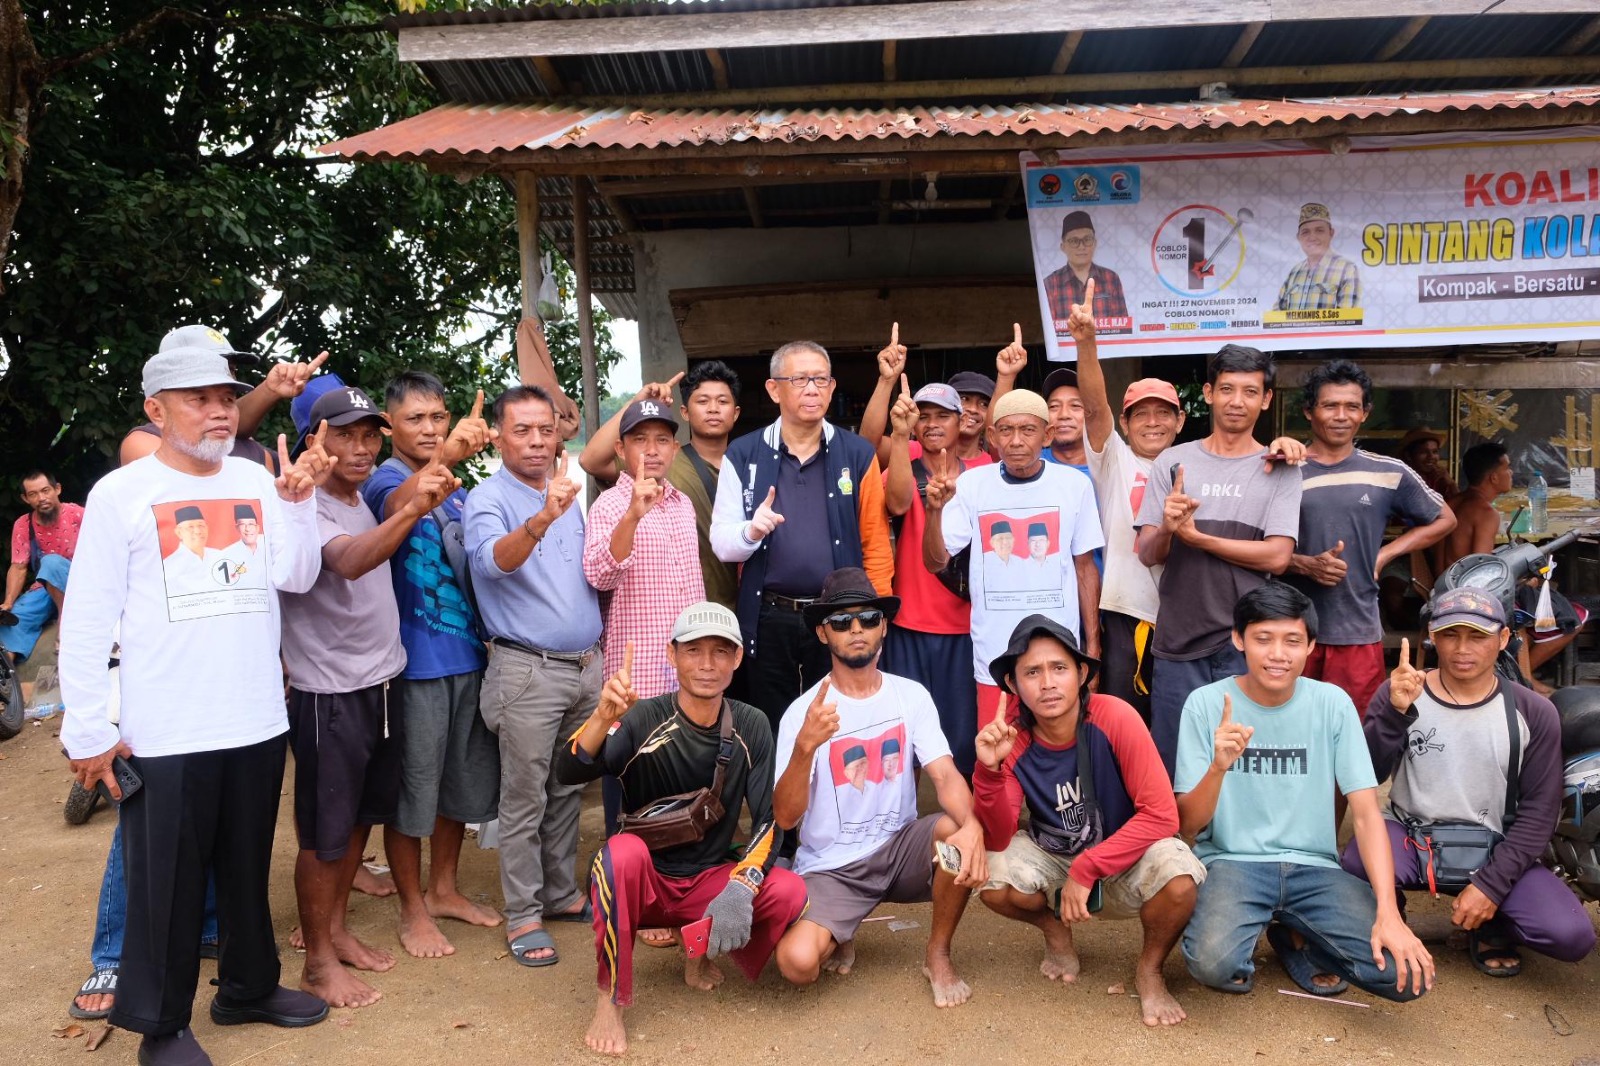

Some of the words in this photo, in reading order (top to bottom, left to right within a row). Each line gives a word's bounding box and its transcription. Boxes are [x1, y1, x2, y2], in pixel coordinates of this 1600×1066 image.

[1465, 168, 1599, 207] KOALI
[1156, 244, 1187, 252] COBLOS
[1362, 218, 1516, 266] SINTANG
[1183, 217, 1205, 290] 1
[1423, 276, 1497, 299] Kompak
[1514, 273, 1585, 294] Bersatu
[1142, 301, 1168, 309] INGAT
[1191, 298, 1236, 307] NOVEMBER
[1237, 297, 1257, 305] 2024
[1164, 309, 1198, 318] COBLOS
[1198, 308, 1230, 317] NOMOR
[1230, 308, 1235, 316] 1
[1231, 319, 1260, 328] MERDEKA
[347, 390, 370, 409] LA
[640, 400, 660, 416] LA
[748, 463, 757, 490] 1
[1201, 483, 1242, 498] BRKL
[218, 561, 230, 584] 1
[688, 611, 732, 628] PUMA
[1233, 755, 1301, 775] DENIM
[1055, 776, 1082, 812] LIV
